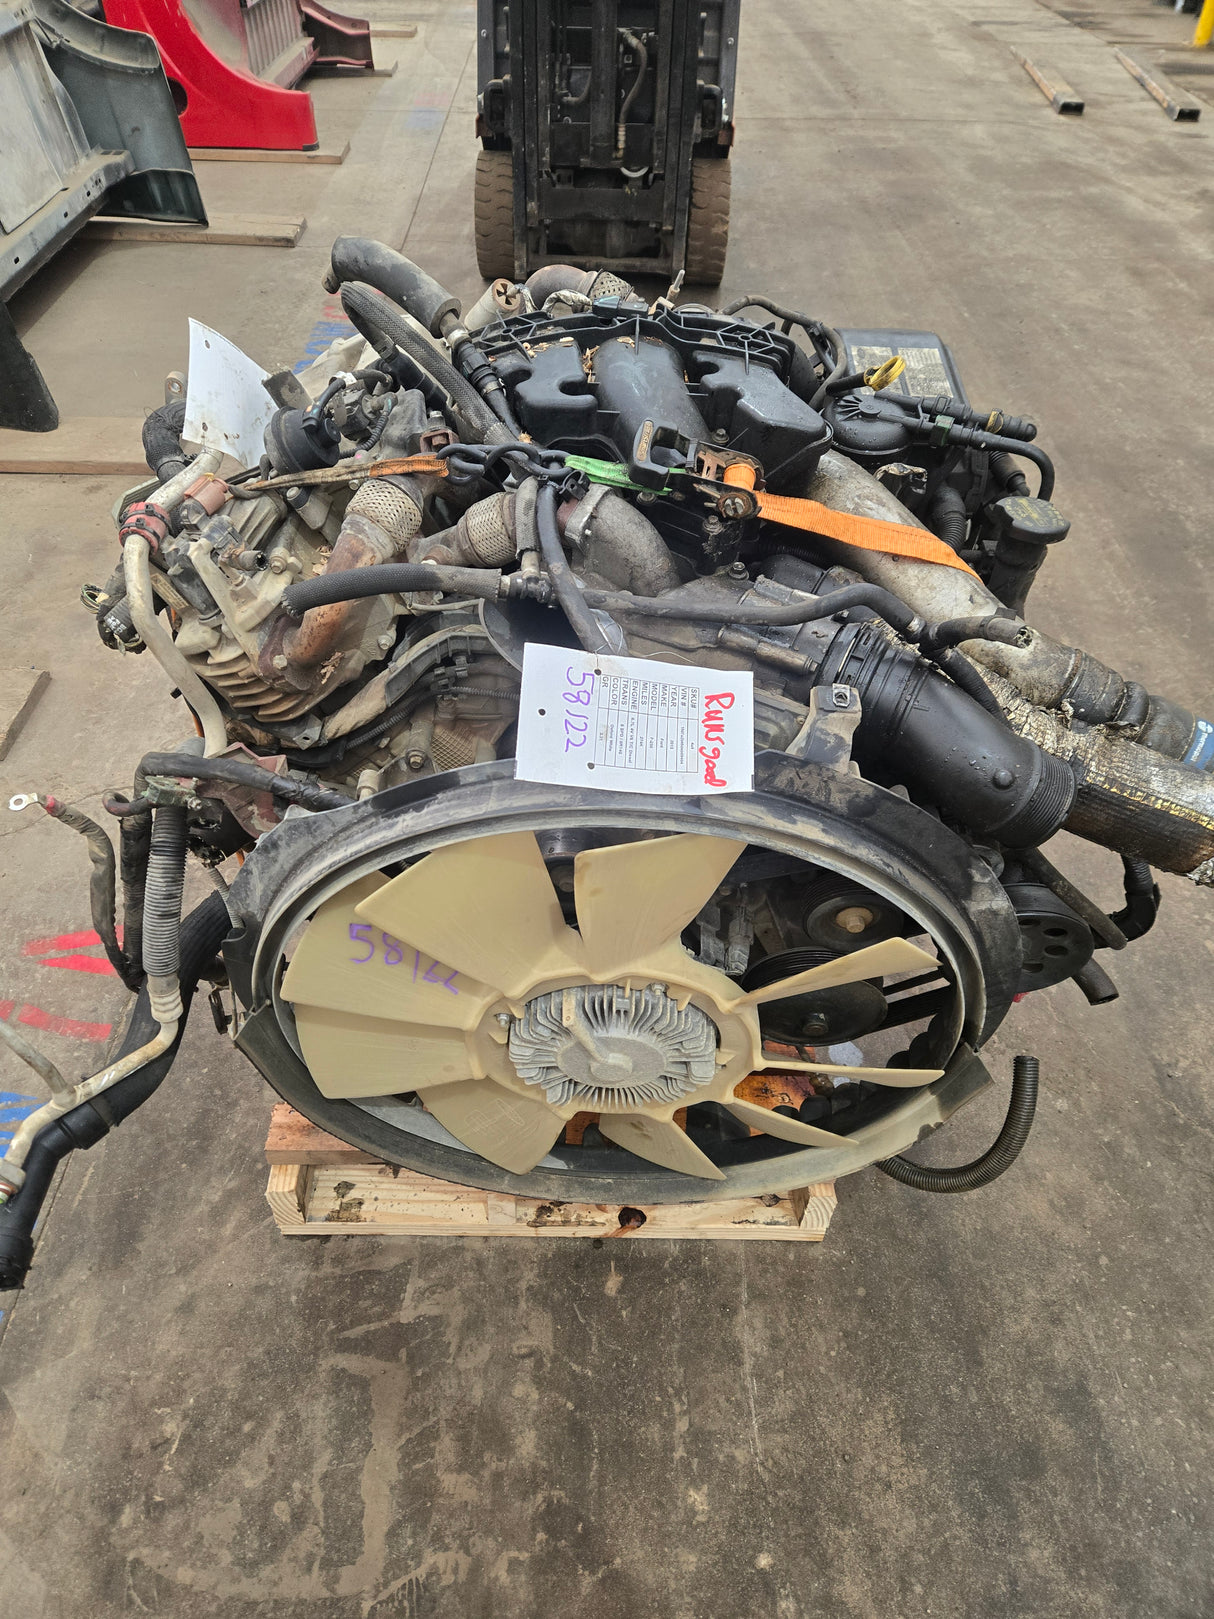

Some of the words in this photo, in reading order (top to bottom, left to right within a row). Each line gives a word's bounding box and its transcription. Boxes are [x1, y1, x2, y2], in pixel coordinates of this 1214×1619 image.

[602, 676, 609, 688] GR
[611, 677, 619, 705] COLOR
[621, 679, 629, 706] TRANS
[631, 680, 639, 710] ENGINE
[660, 684, 668, 707] MAKE
[650, 683, 658, 711] MODEL
[670, 686, 678, 707] YEAR
[690, 688, 698, 709] SKU#
[698, 747, 728, 788] good
